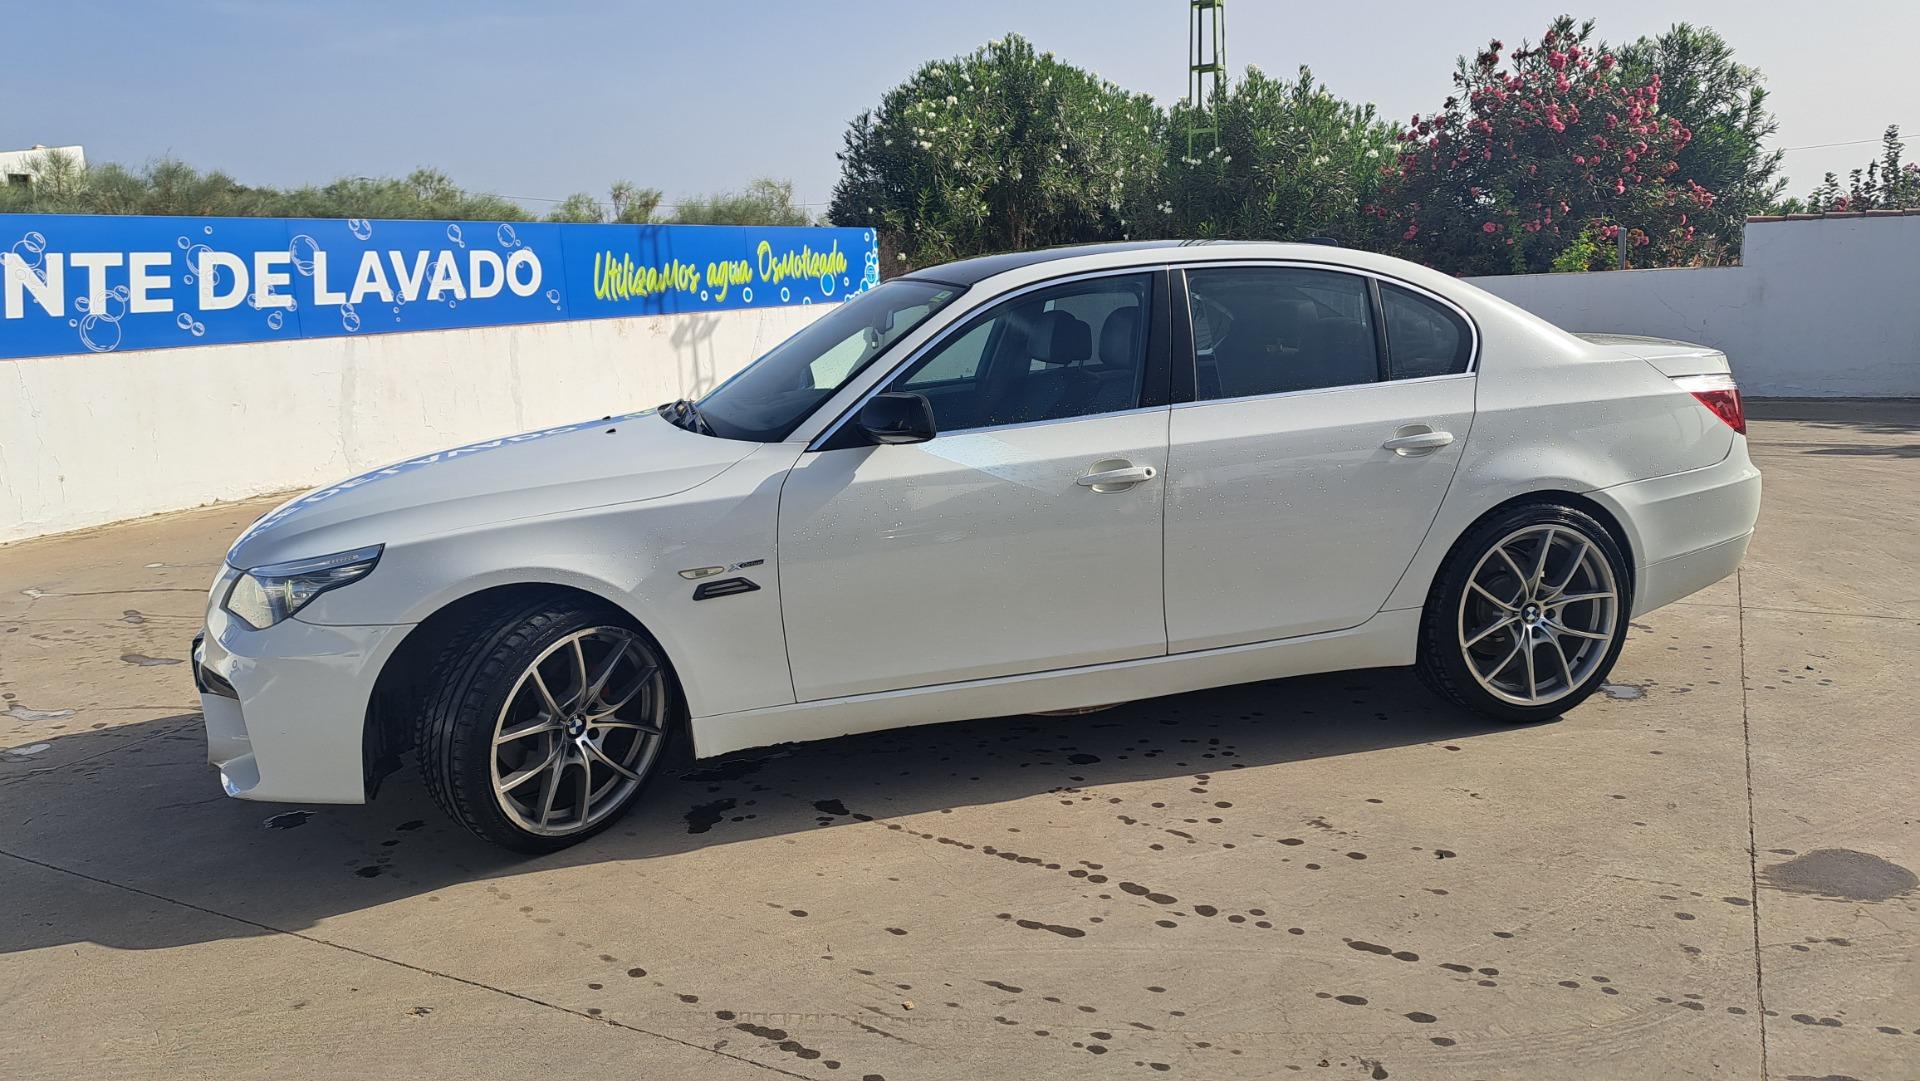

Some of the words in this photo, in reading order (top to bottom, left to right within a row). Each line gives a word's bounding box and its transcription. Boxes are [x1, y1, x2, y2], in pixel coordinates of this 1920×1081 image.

[4, 252, 173, 319] NTE
[199, 252, 292, 310] DE
[314, 249, 542, 305] LAVADO
[706, 260, 753, 302] agua
